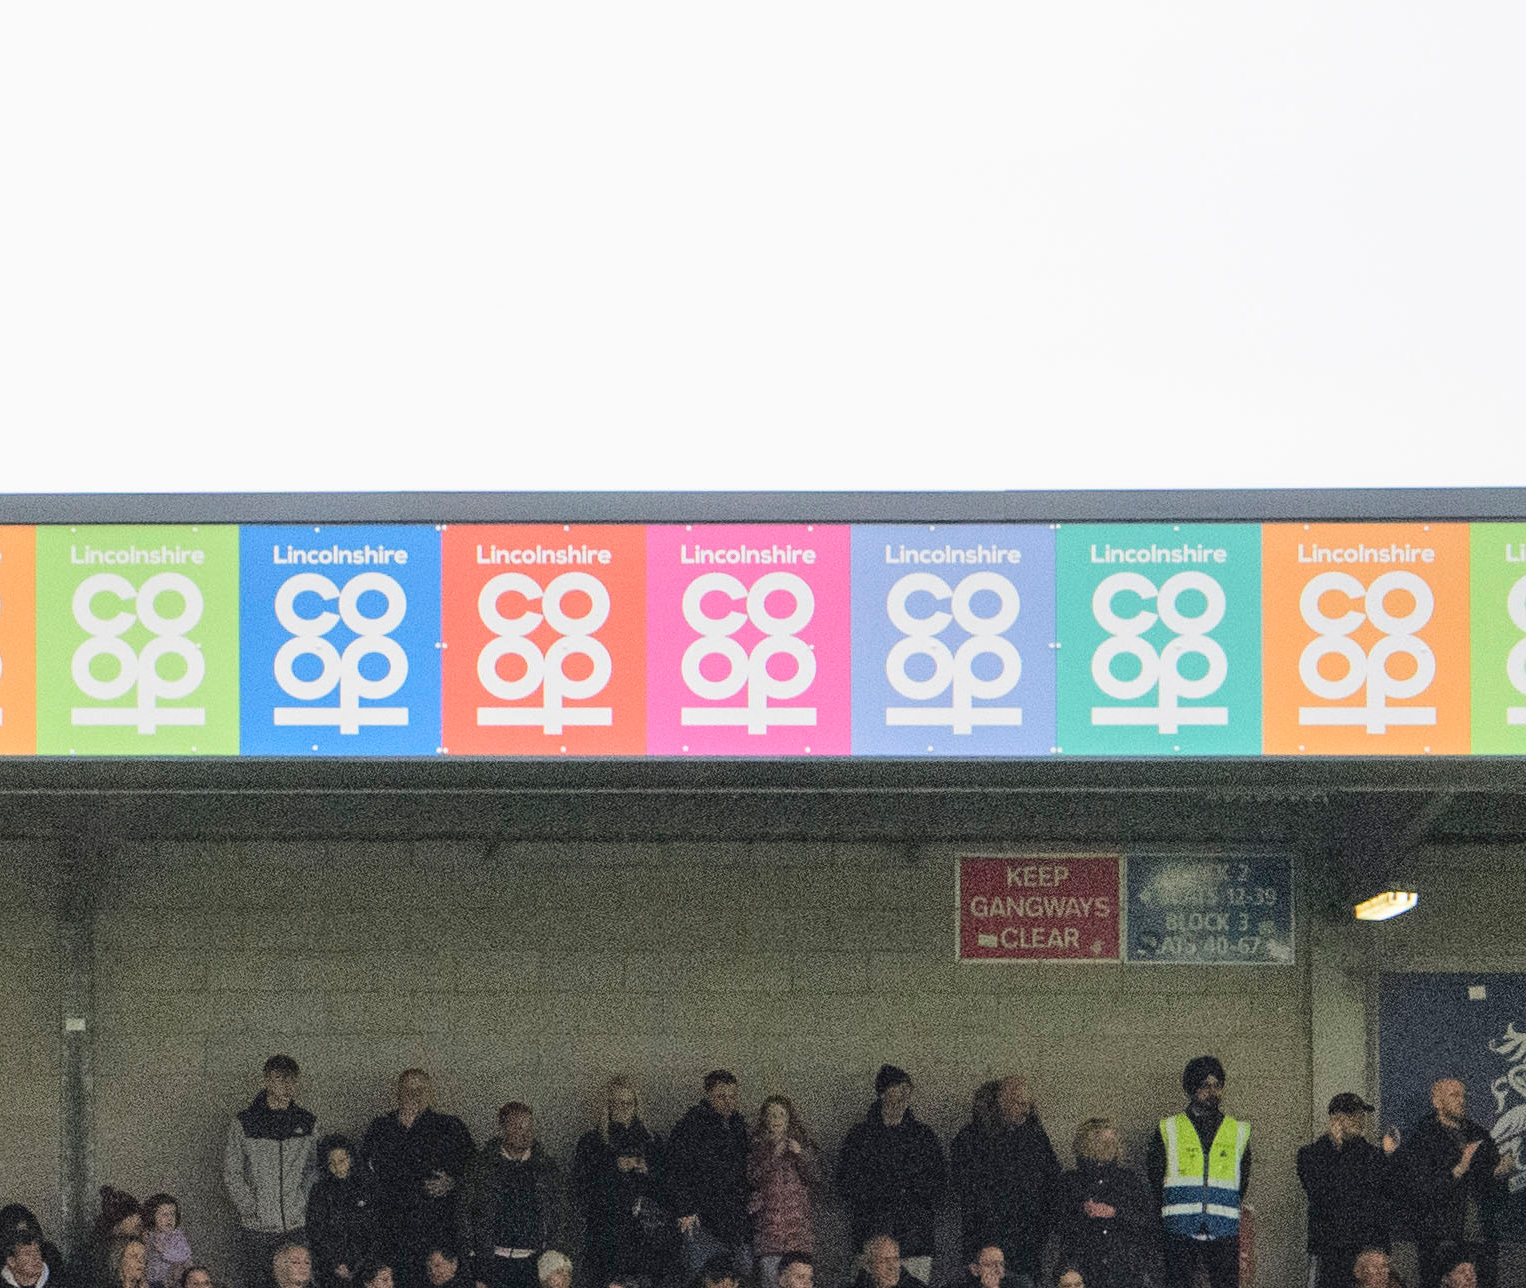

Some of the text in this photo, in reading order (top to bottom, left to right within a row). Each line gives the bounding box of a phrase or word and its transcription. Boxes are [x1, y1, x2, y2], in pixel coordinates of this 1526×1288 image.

[70, 546, 206, 566] Lincolnshire
[273, 546, 408, 566] Lincolnshire
[477, 546, 612, 566] Lincolnshire
[680, 545, 816, 565] Lincolnshire
[884, 545, 1022, 565] Lincolnshire
[1090, 544, 1228, 564] Lincolnshire
[1298, 544, 1437, 564] Lincolnshire
[1005, 866, 1070, 887] KEEP
[969, 896, 1111, 918] GANGWAYS
[1226, 888, 1278, 908] 12-39
[1165, 912, 1250, 932] BLOCK 3
[1000, 927, 1080, 949] CLEAR
[1138, 935, 1262, 956] ATS 40-67
